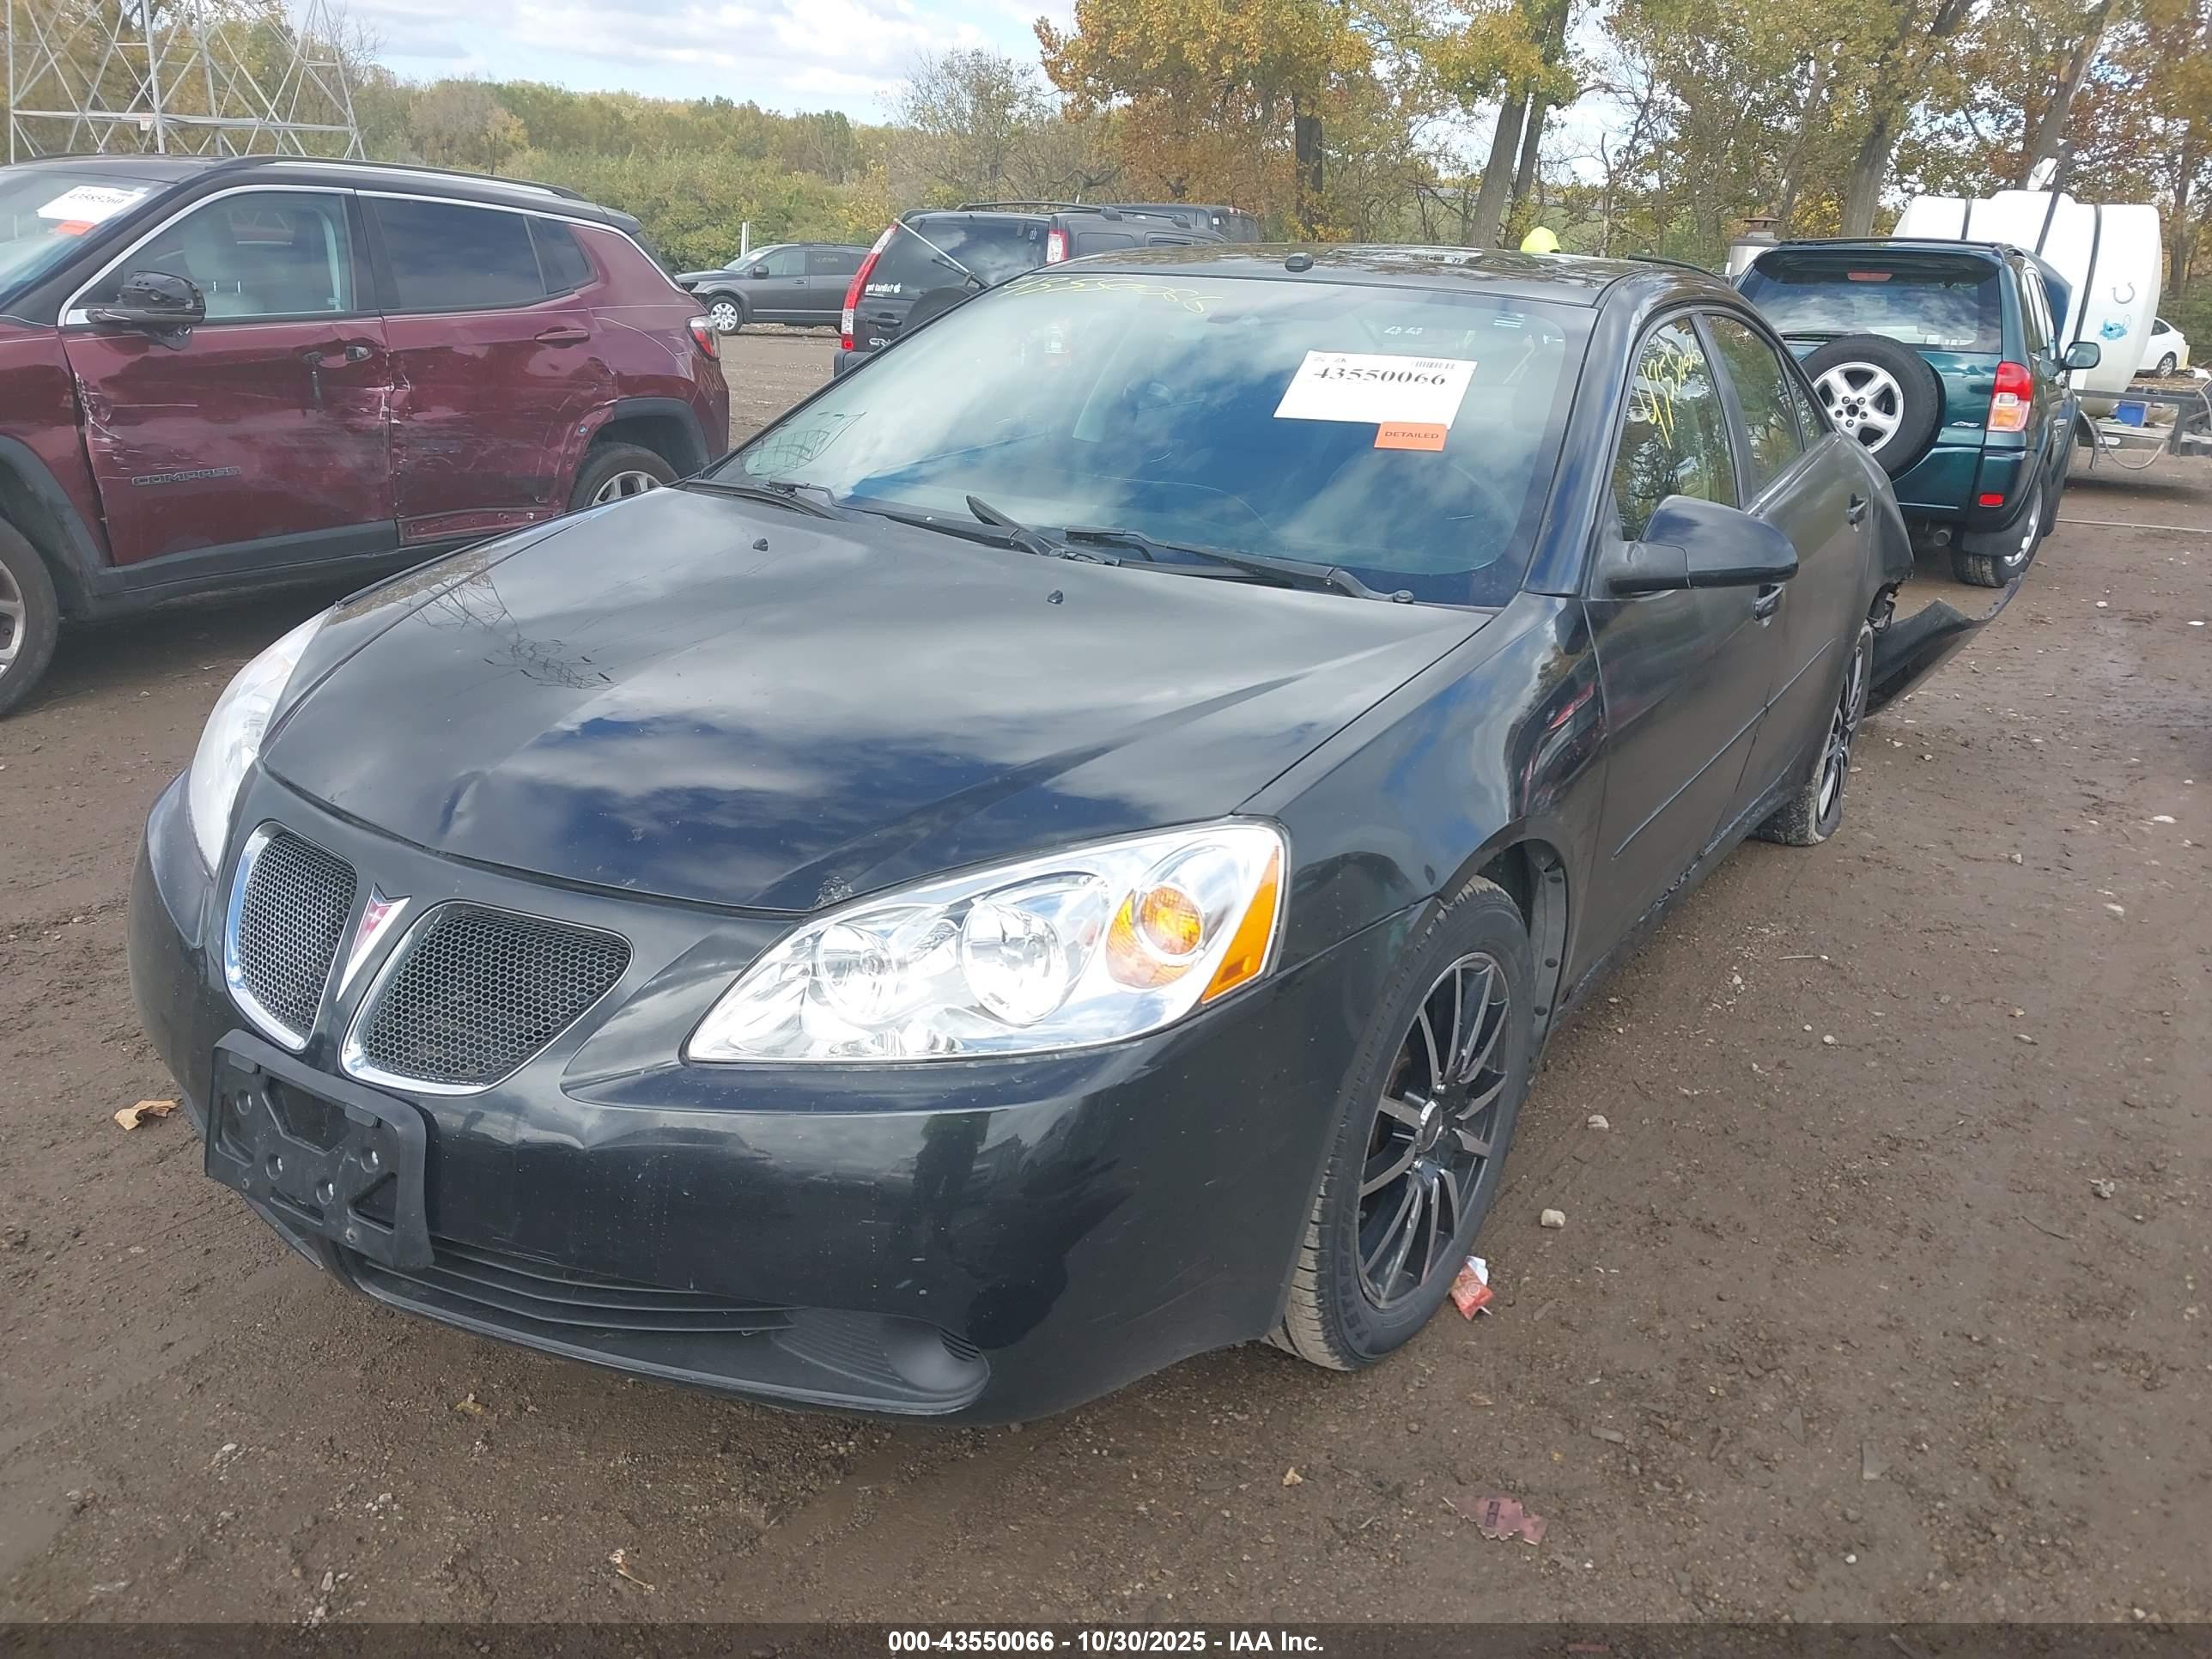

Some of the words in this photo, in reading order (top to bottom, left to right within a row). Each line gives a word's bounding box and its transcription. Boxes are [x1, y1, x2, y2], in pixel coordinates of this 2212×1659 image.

[1313, 367, 1446, 386] 43550066
[1384, 430, 1439, 440] DETAILED
[131, 466, 241, 486] COMPASS
